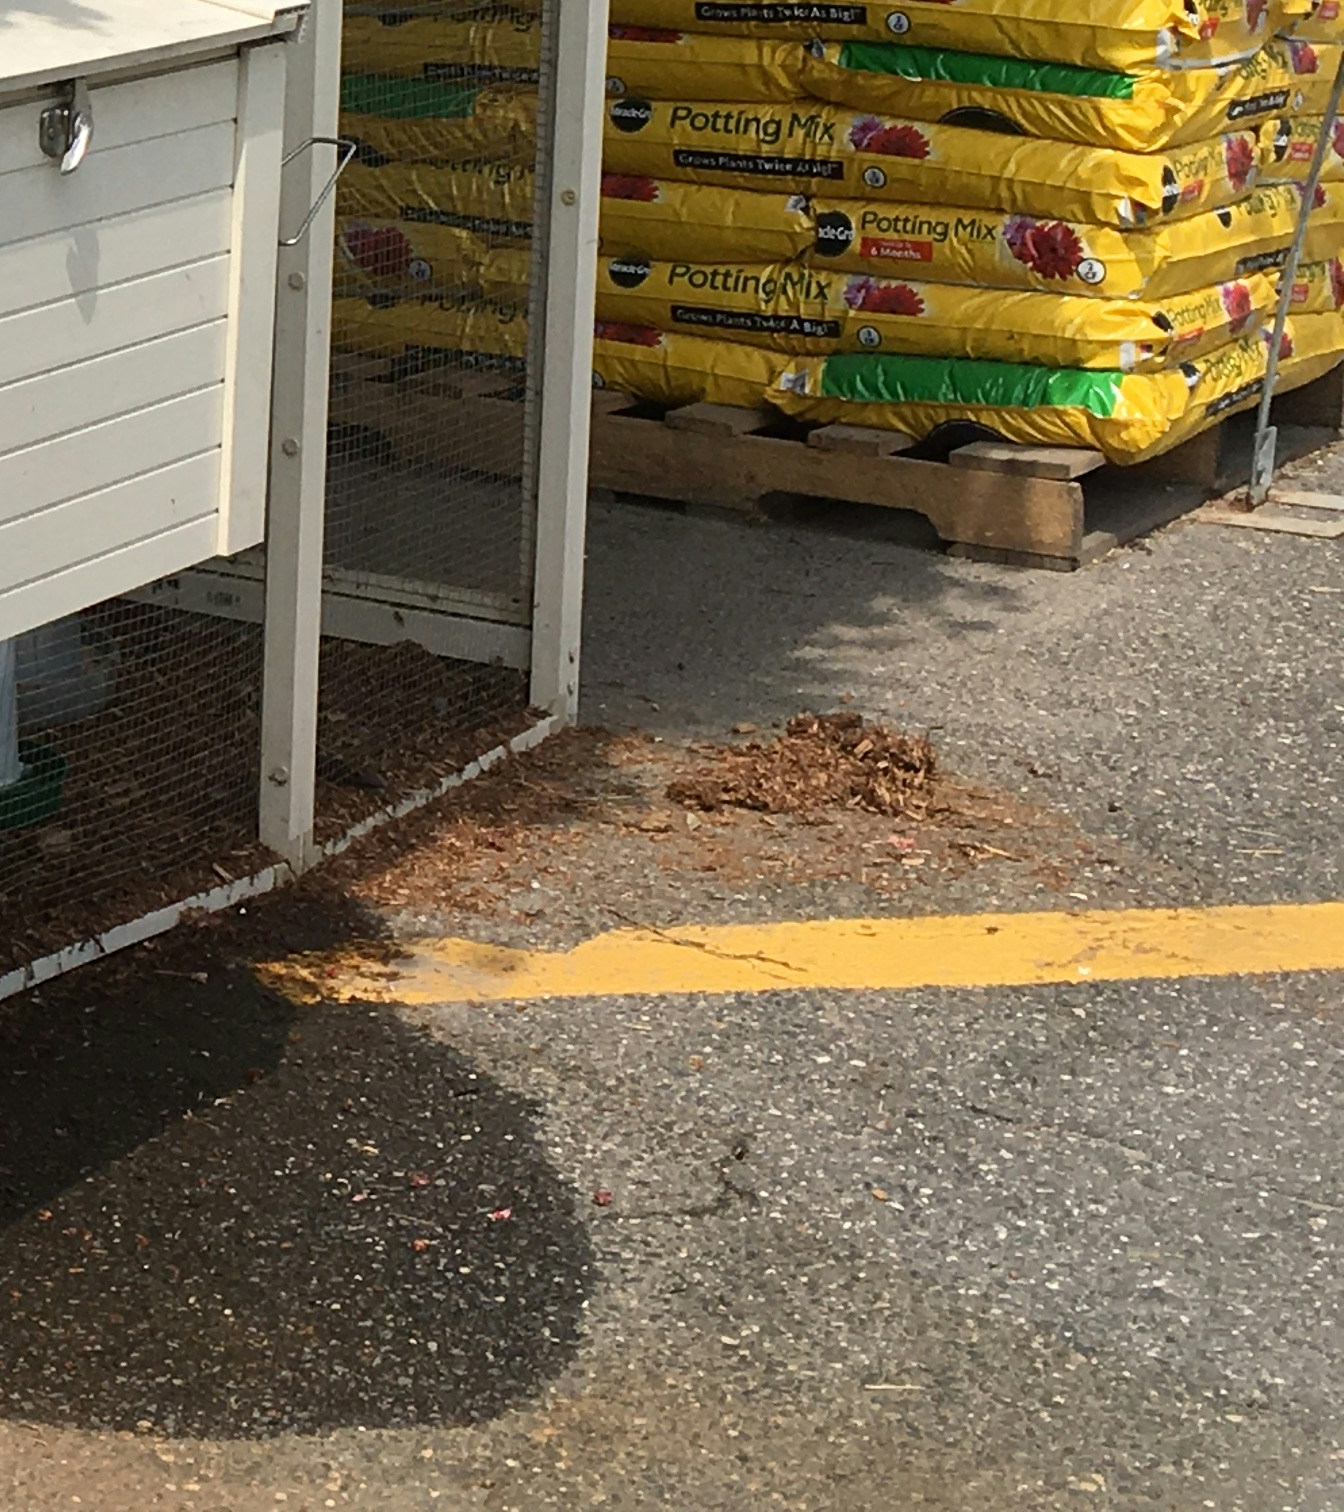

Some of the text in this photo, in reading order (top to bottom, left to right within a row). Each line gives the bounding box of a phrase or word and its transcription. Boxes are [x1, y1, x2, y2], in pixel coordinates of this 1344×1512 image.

[669, 106, 837, 144] Potting Mix
[862, 210, 996, 242] Potting Mix
[667, 263, 831, 304] Potting Mix
